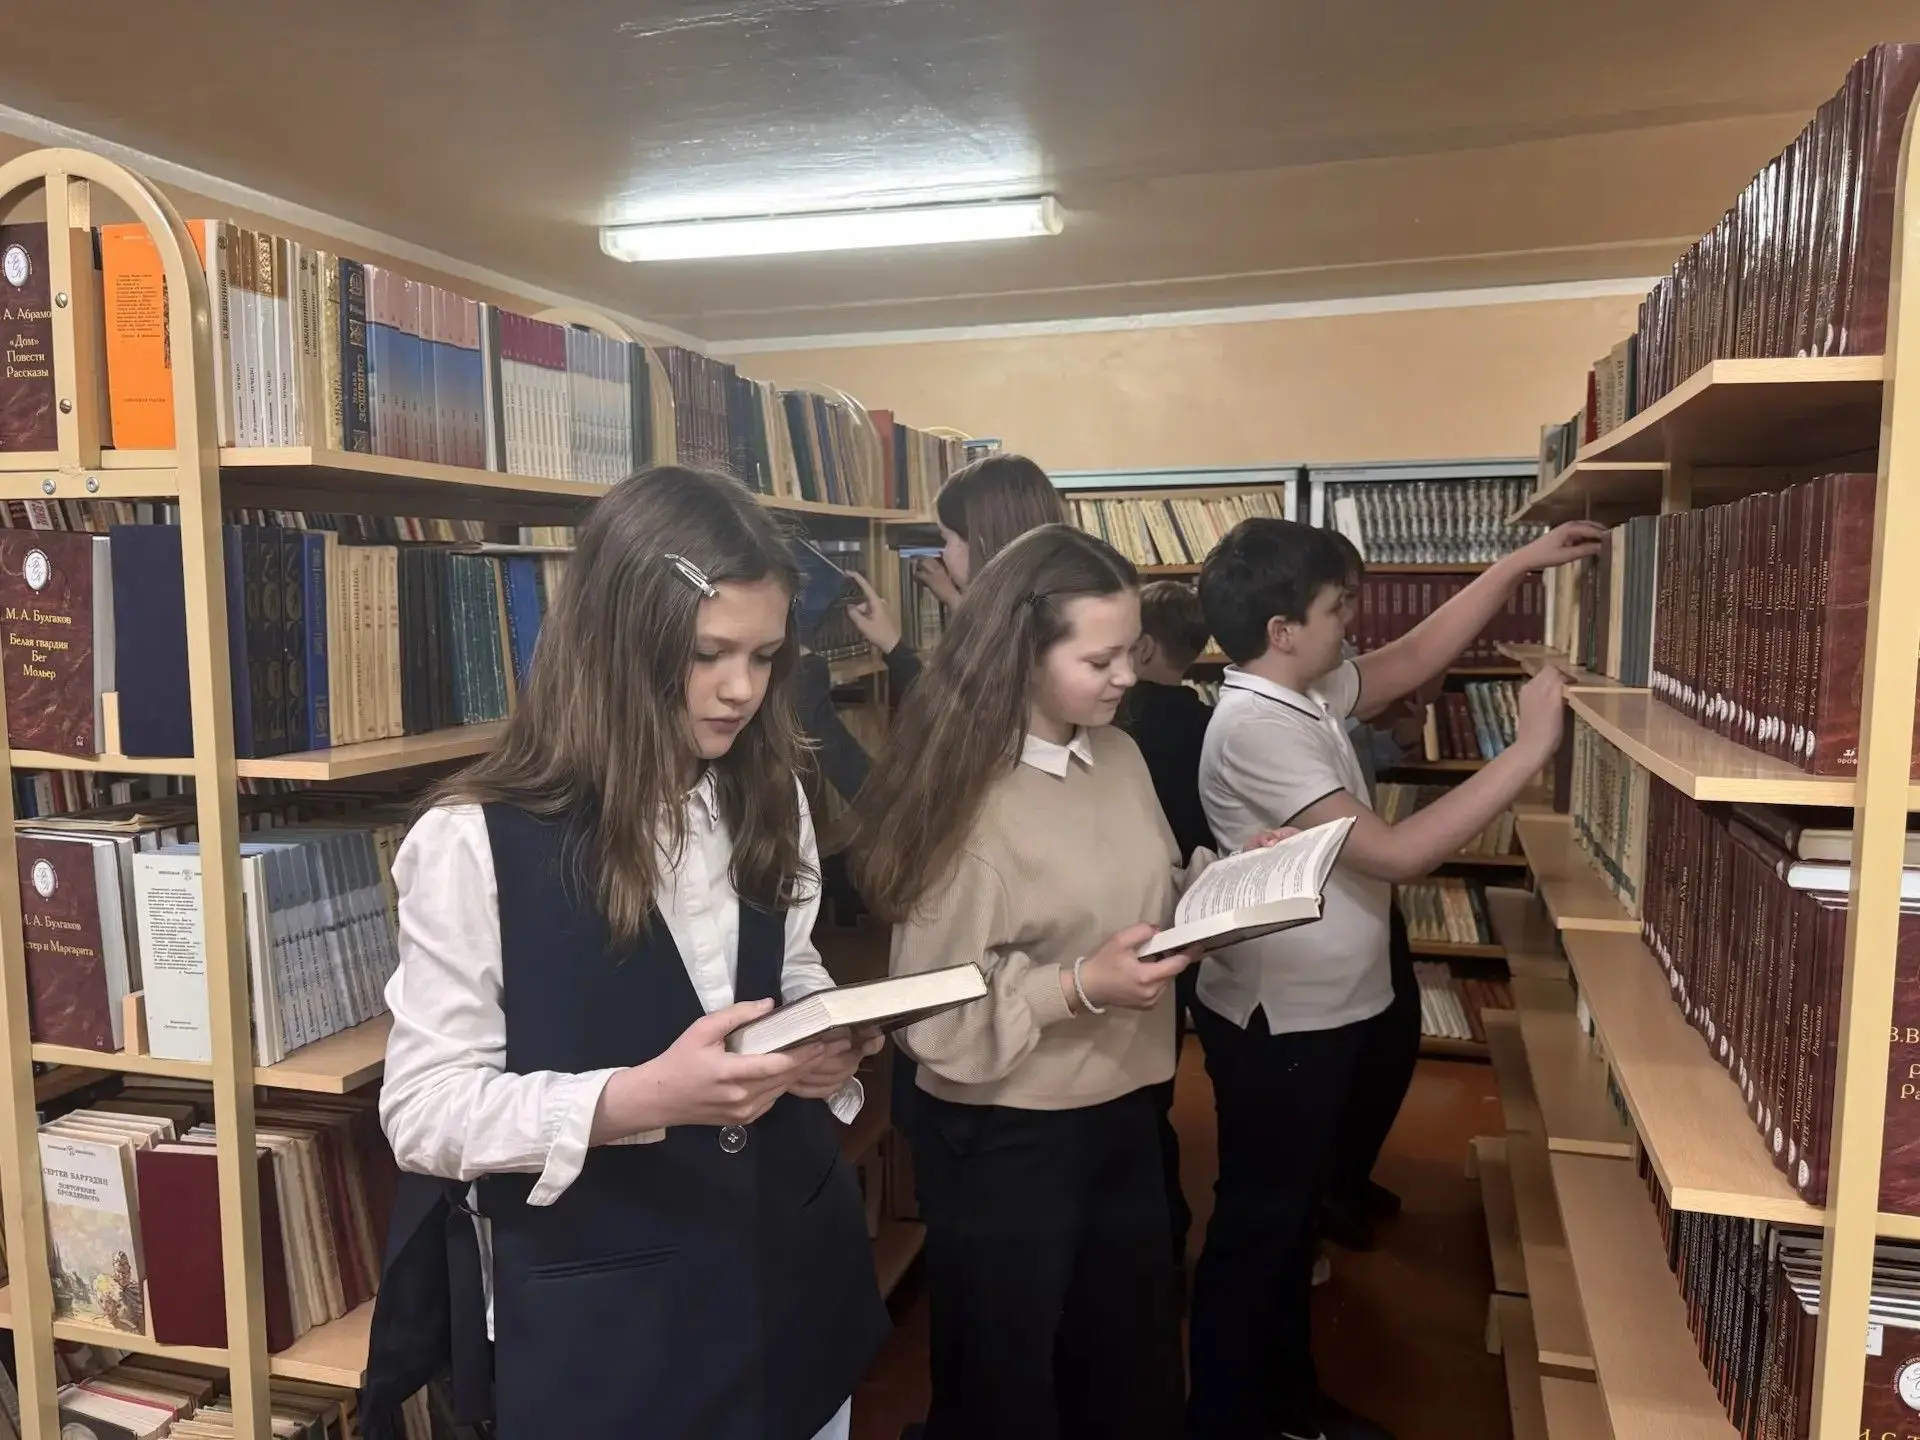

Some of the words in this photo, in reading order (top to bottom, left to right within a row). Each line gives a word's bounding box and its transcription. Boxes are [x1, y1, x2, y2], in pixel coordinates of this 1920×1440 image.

[17, 307, 52, 322] Абрамо
[10, 334, 40, 349] «Дом»
[7, 350, 45, 363] Повести
[7, 365, 49, 378] Рассказы
[6, 607, 19, 620] М.
[20, 608, 31, 620] А.
[33, 609, 72, 624] Булгаков
[9, 632, 34, 647] Белая
[36, 639, 69, 650] гвардия
[31, 649, 48, 663] Бег
[23, 663, 56, 681] Мольер
[44, 915, 82, 931] Булгаков
[49, 940, 94, 957] Маргарита
[1812, 1005, 1822, 1057] Рассказы
[1793, 1055, 1805, 1130] Литературные
[1799, 1003, 1809, 1053] портреты
